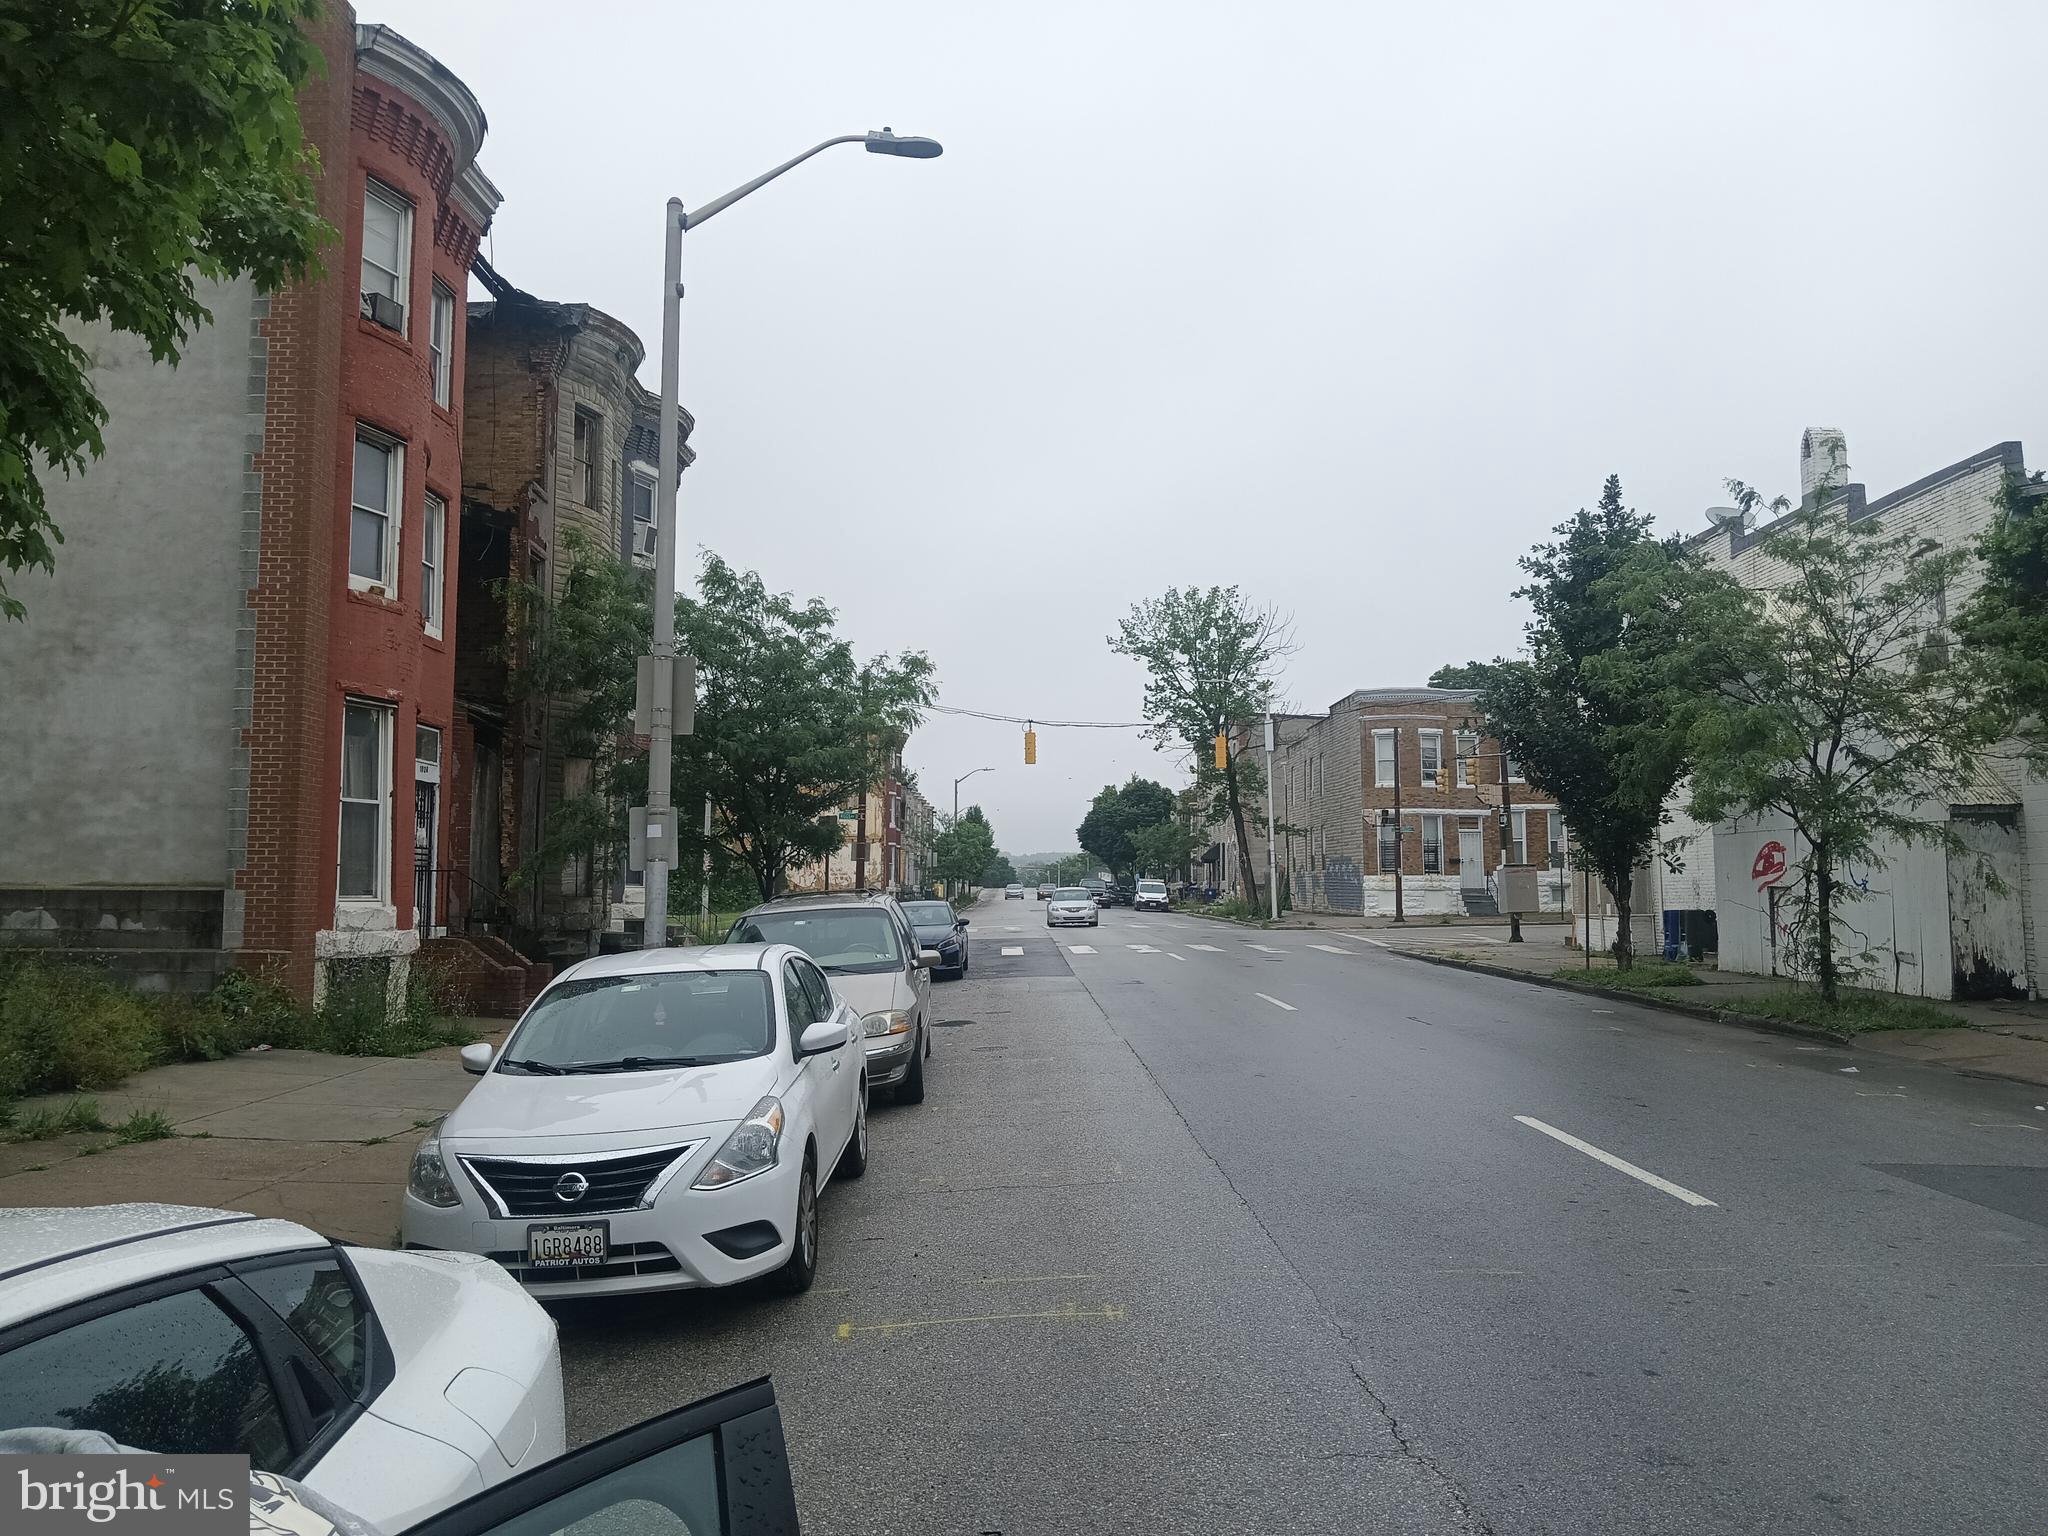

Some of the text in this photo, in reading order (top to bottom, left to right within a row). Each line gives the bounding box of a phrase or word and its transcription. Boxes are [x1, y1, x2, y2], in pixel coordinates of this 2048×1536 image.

[534, 1235, 602, 1260] 1GR8488
[535, 1257, 600, 1267] PATRIOT AUTOS
